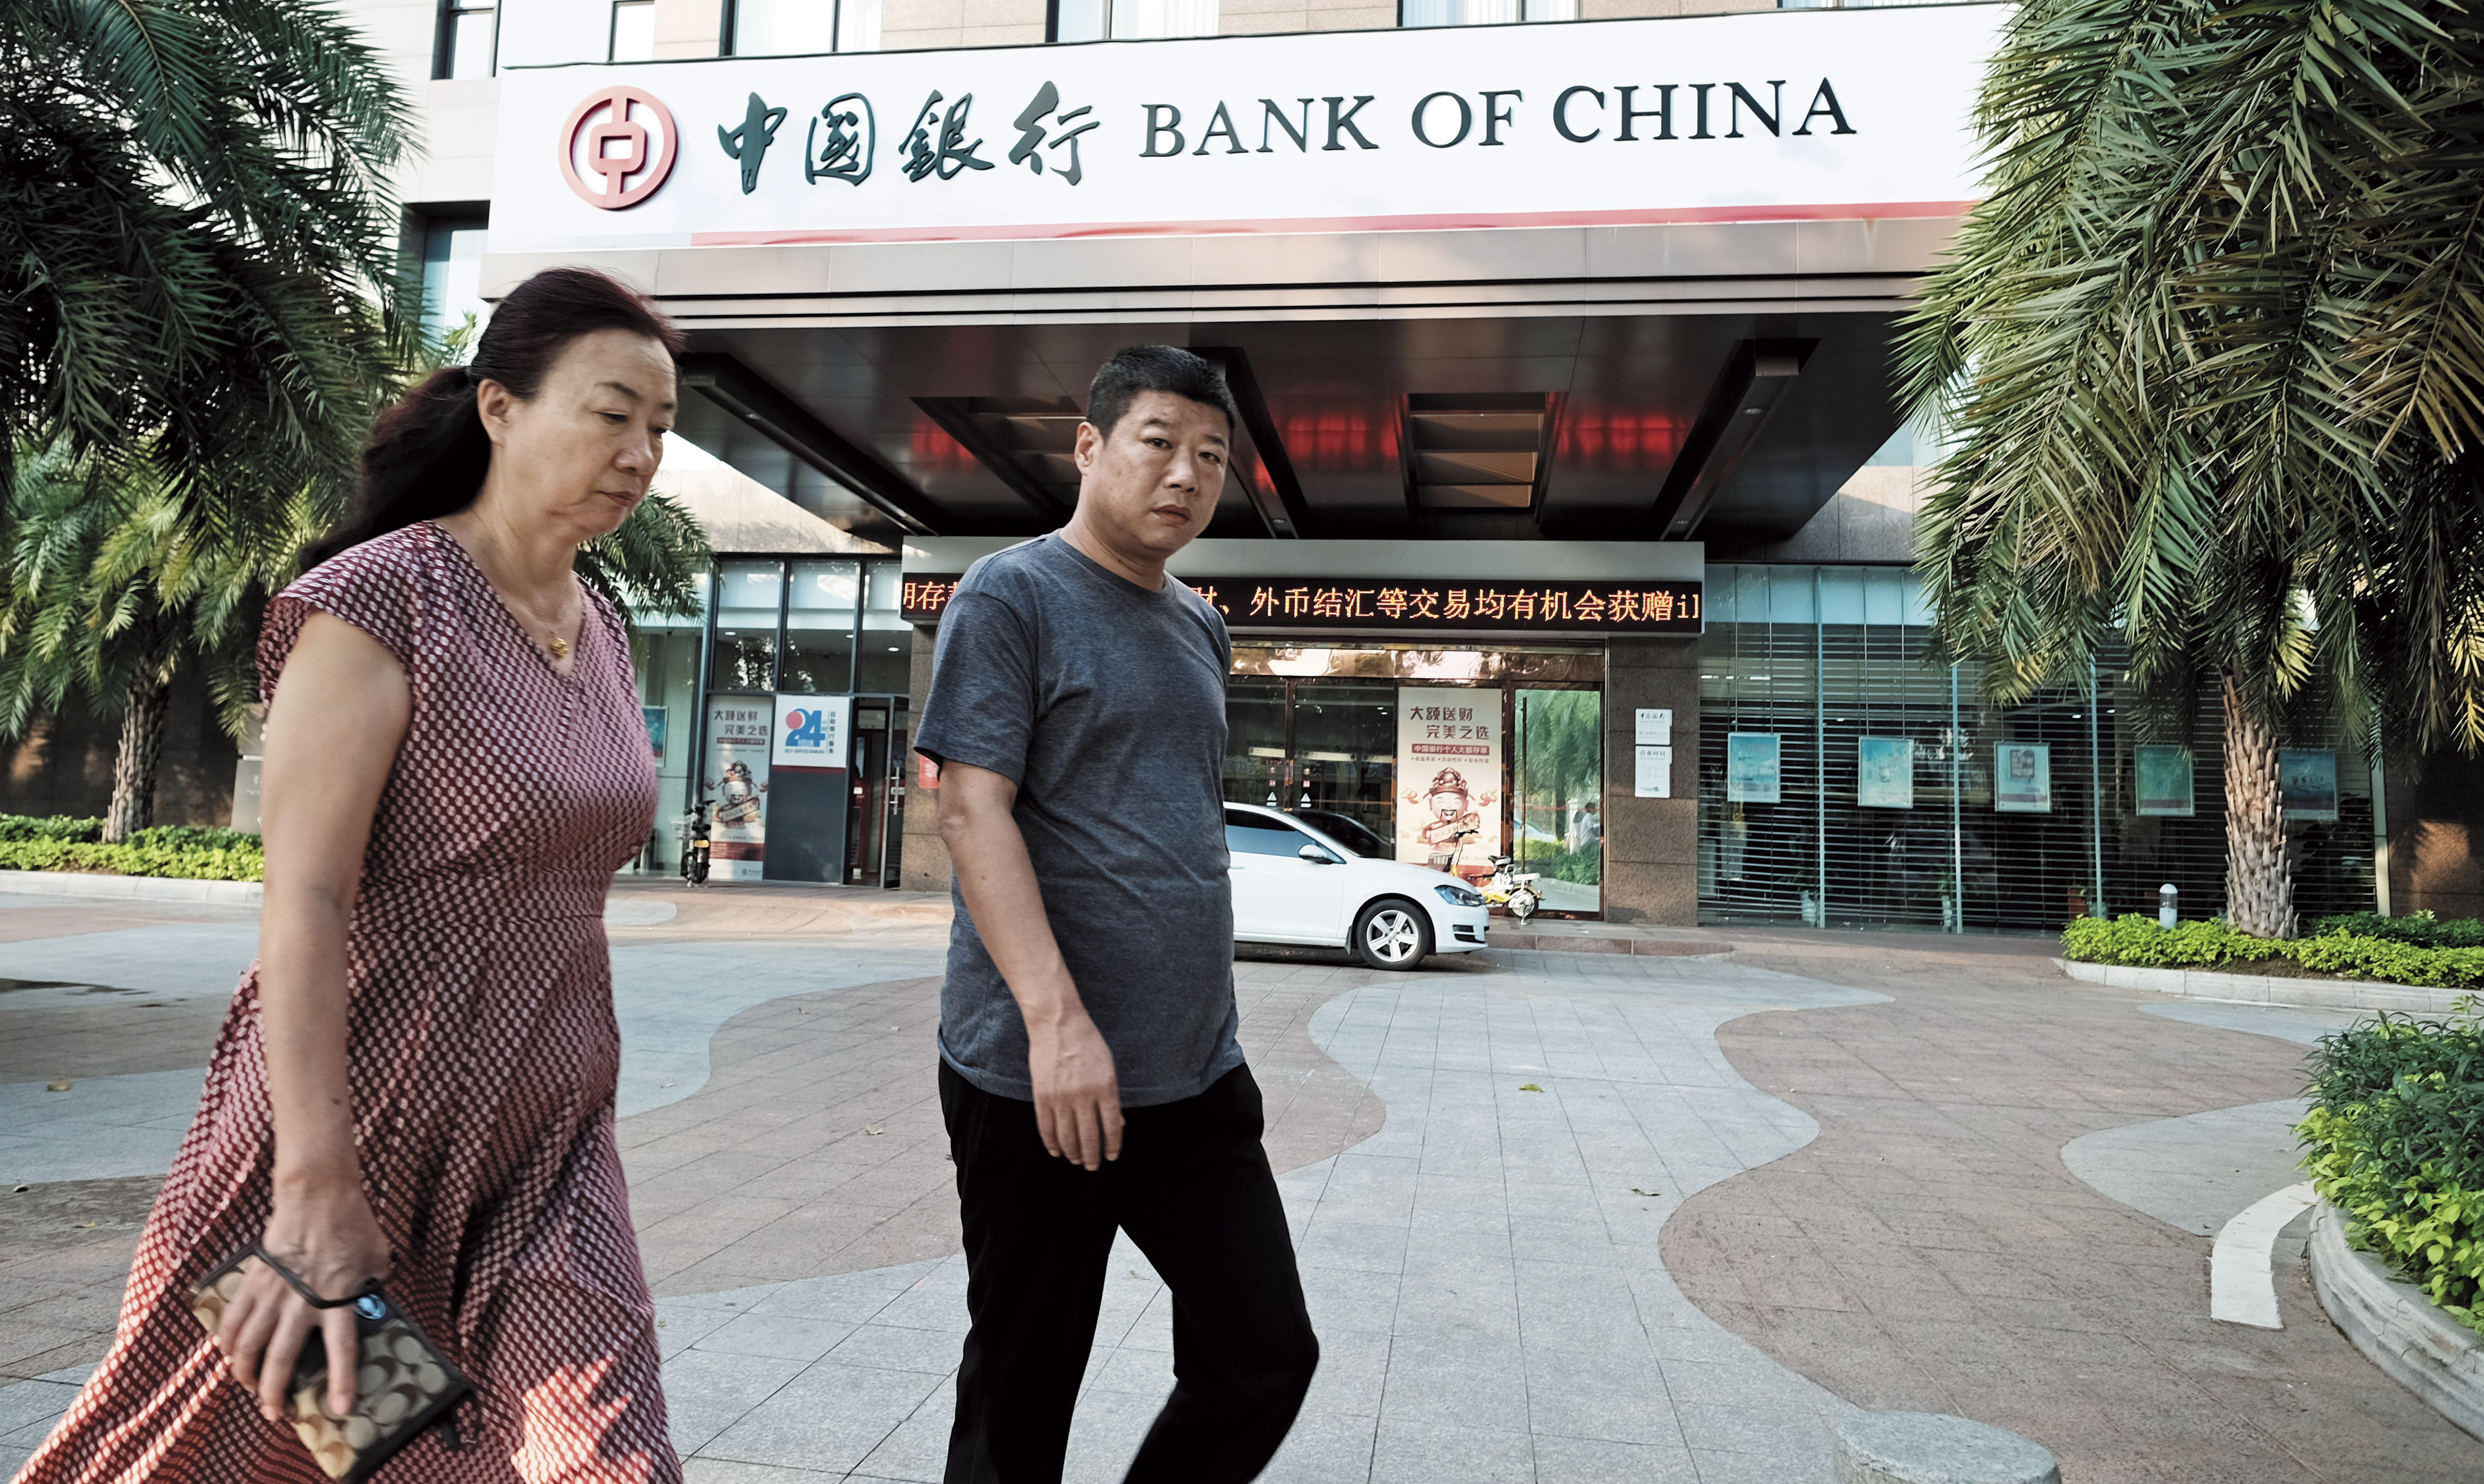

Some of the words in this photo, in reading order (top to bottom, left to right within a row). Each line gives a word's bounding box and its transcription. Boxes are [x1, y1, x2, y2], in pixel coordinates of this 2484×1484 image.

[1139, 95, 1380, 158] BANK
[1411, 89, 1523, 149] OF
[1552, 77, 1857, 143] CHINA
[786, 708, 826, 747] 24
[1410, 706, 1473, 722] 大额送财
[1426, 725, 1490, 740] 完美之选
